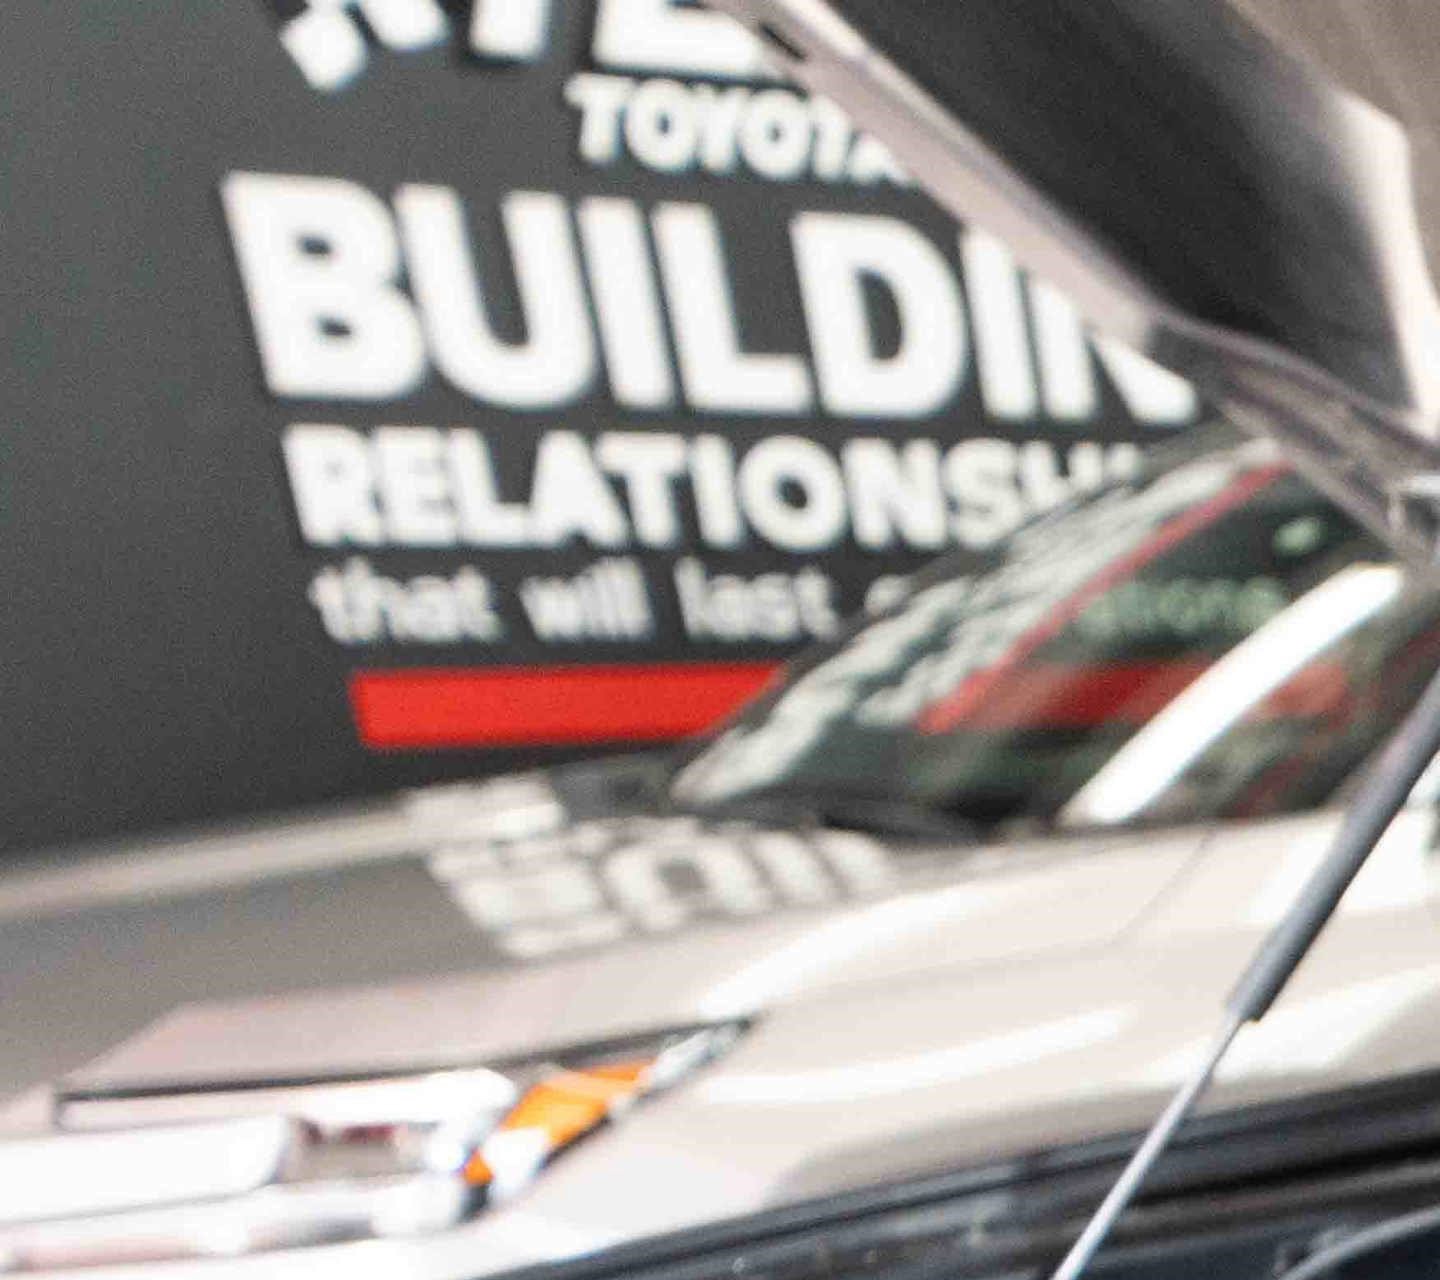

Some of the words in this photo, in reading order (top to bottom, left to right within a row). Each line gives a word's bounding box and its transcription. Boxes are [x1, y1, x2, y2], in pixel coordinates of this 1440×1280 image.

[309, 556, 496, 645] that
[520, 557, 654, 643] will
[674, 557, 842, 643] last
